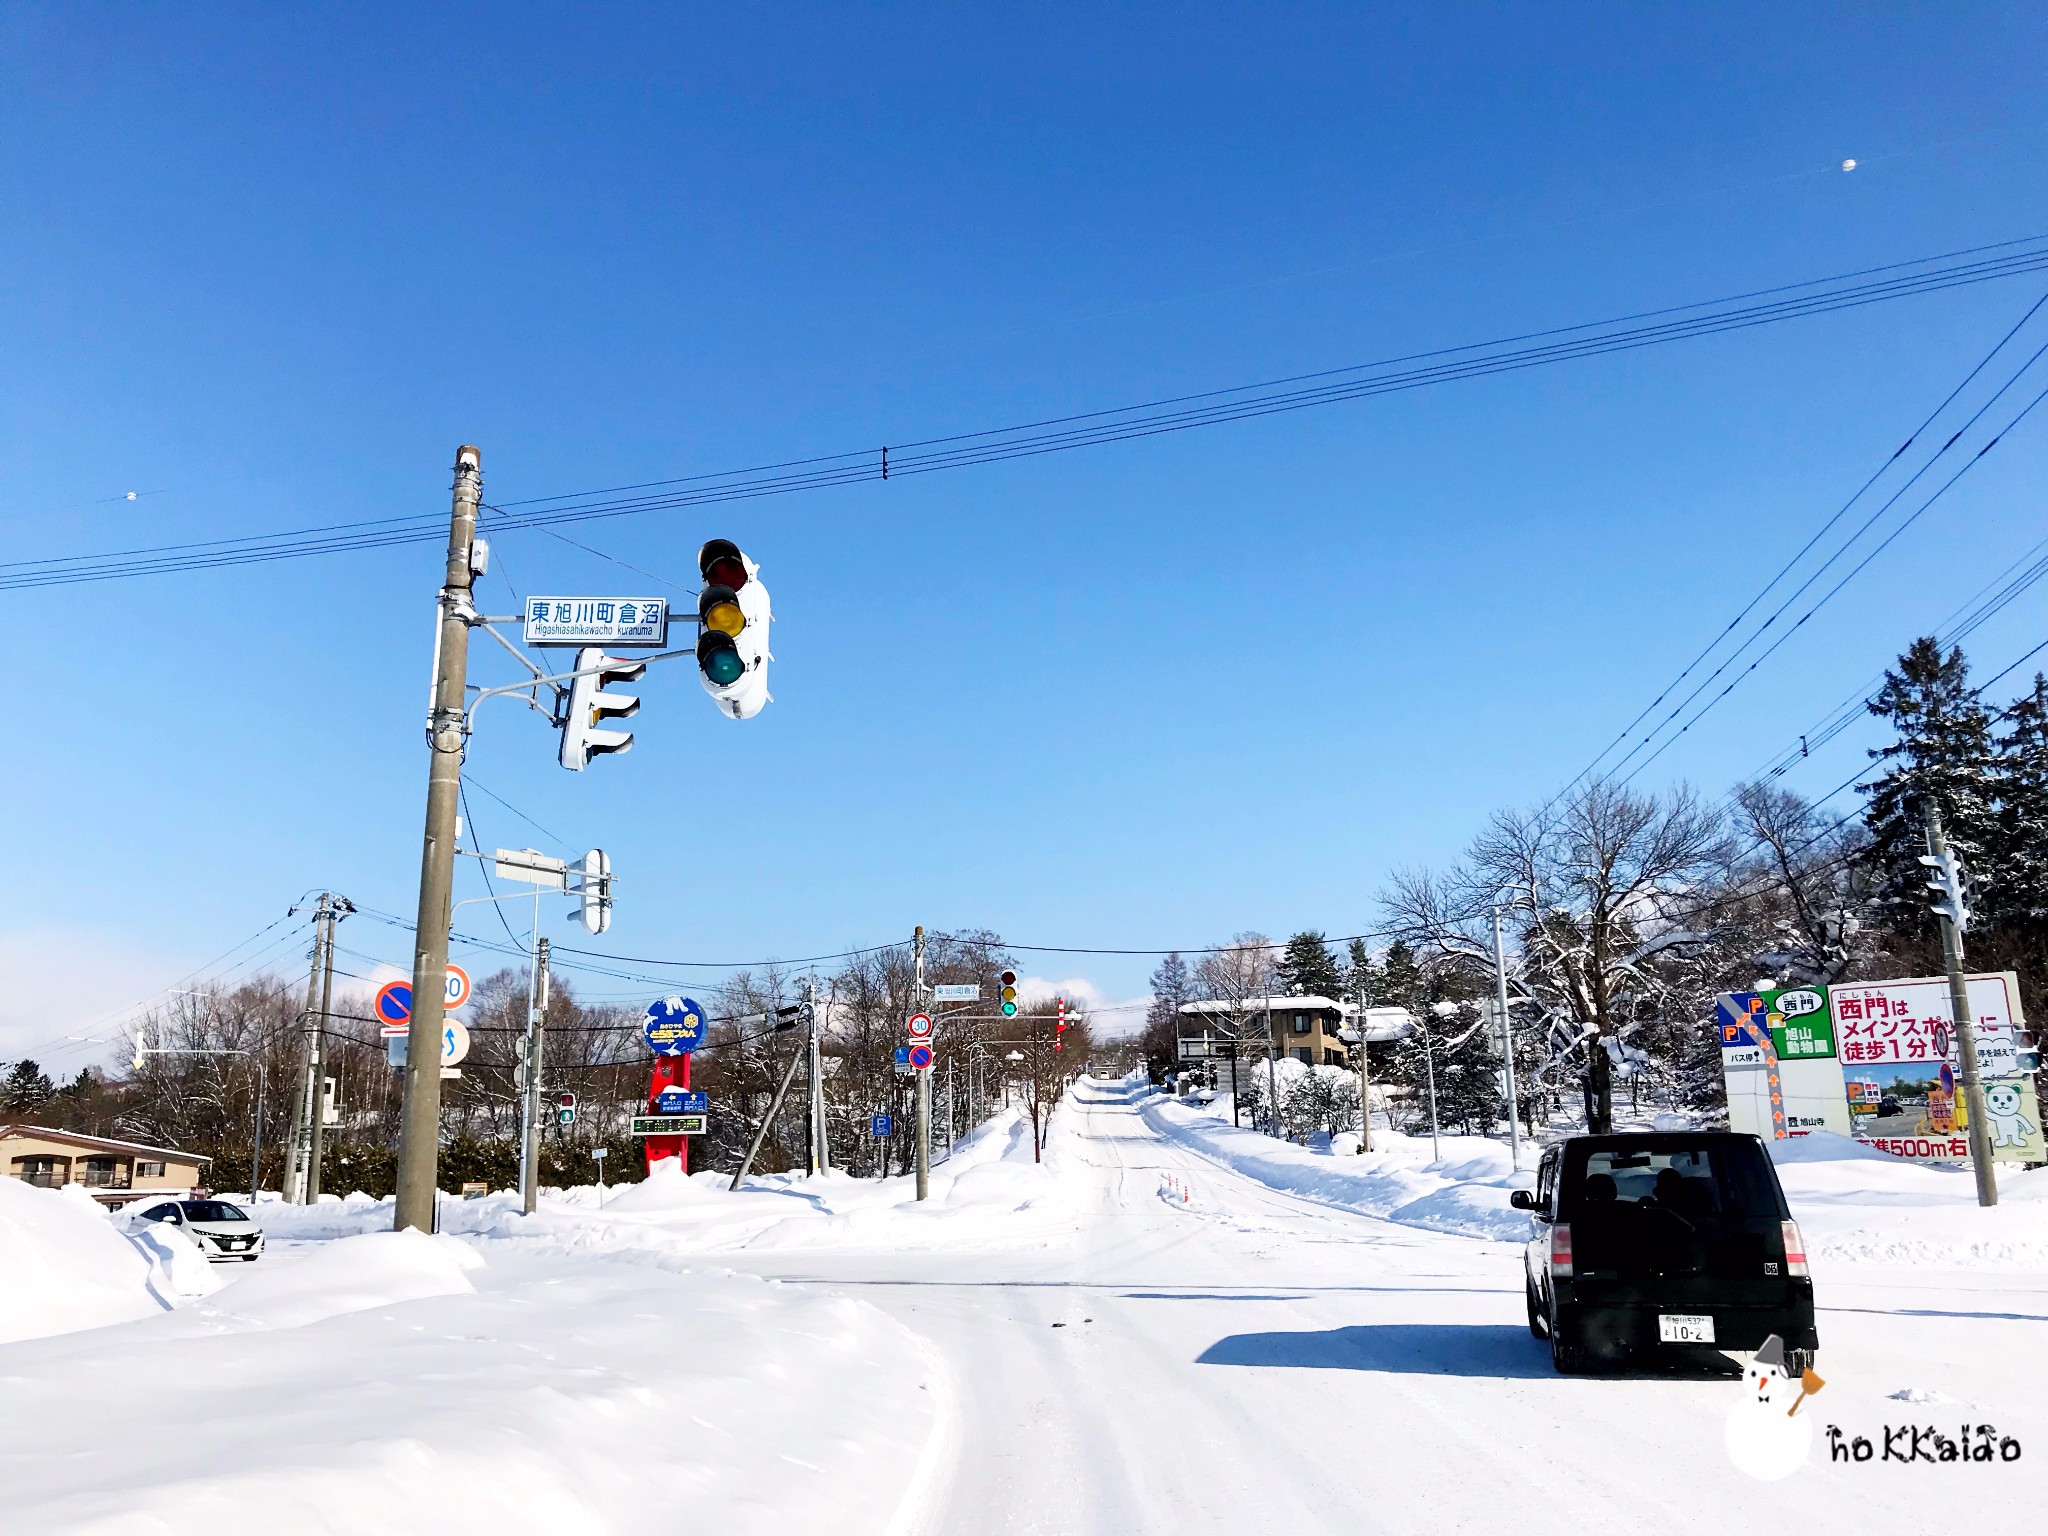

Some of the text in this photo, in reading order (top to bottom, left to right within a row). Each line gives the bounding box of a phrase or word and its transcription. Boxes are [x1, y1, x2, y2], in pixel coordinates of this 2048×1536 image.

[531, 602, 659, 624] 東旭川町倉沼
[535, 624, 653, 636] Higashiasahikawacho kuranuma
[1839, 990, 1885, 999] にしもん
[1750, 999, 1763, 1014] P
[1784, 999, 1814, 1011] 西門
[1838, 997, 1909, 1020] 西門は
[914, 1020, 927, 1031] 30
[1843, 1016, 1999, 1039] メインスポッに
[1724, 1027, 1737, 1040] P
[1785, 1027, 1812, 1040] 旭山
[1786, 1040, 1829, 1054] 動物園
[1731, 1054, 1754, 1062] バス停
[877, 1118, 887, 1128] P
[1800, 1117, 1825, 1126] 旭山寺
[1674, 1326, 1703, 1340] 10-2
